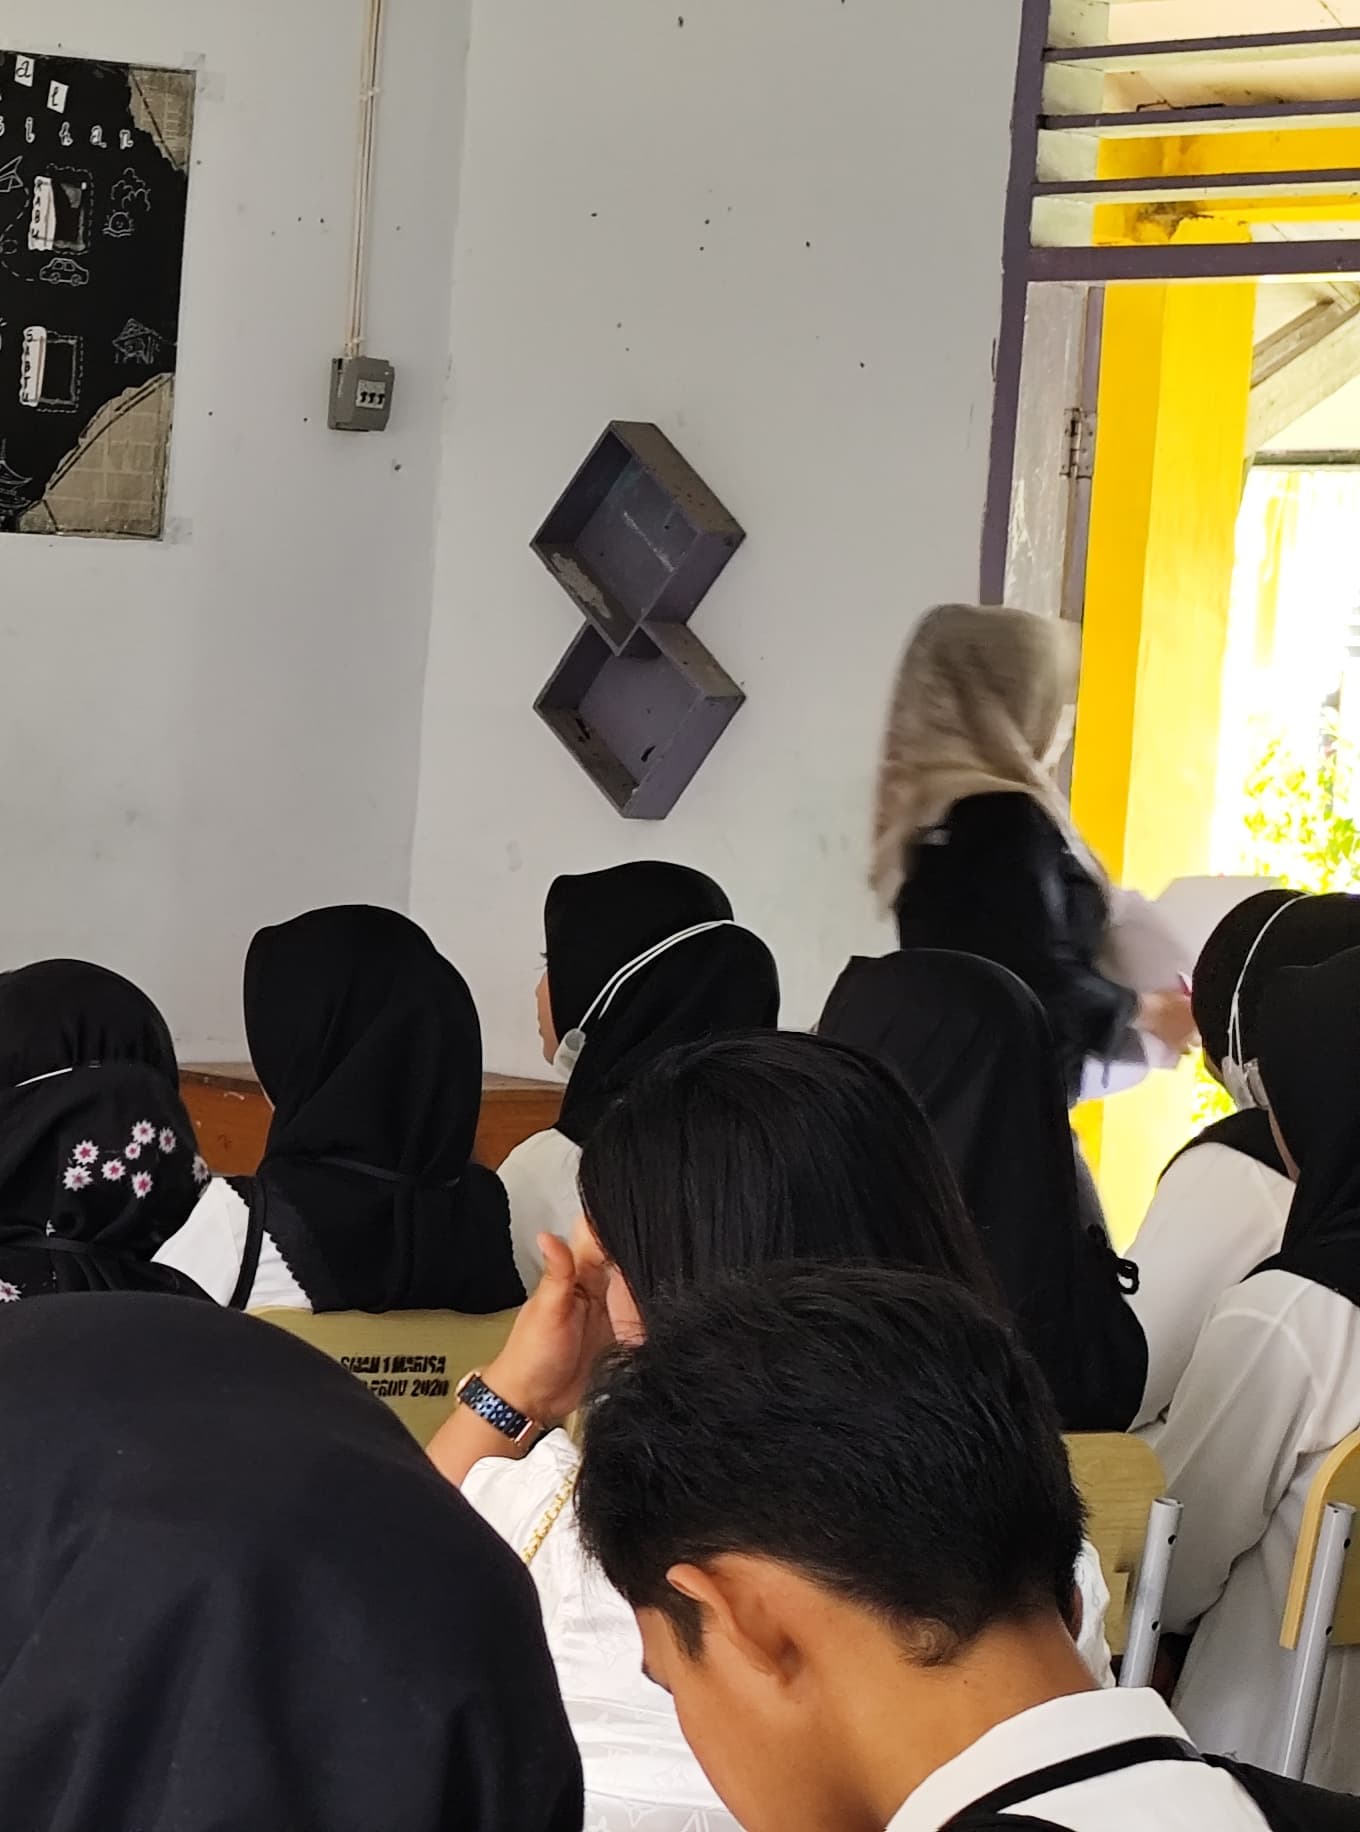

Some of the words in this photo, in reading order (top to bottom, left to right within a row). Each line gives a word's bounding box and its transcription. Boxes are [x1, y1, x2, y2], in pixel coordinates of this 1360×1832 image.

[383, 1356, 391, 1374] 1
[391, 1355, 447, 1374] MARISA
[410, 1379, 450, 1397] 2020
